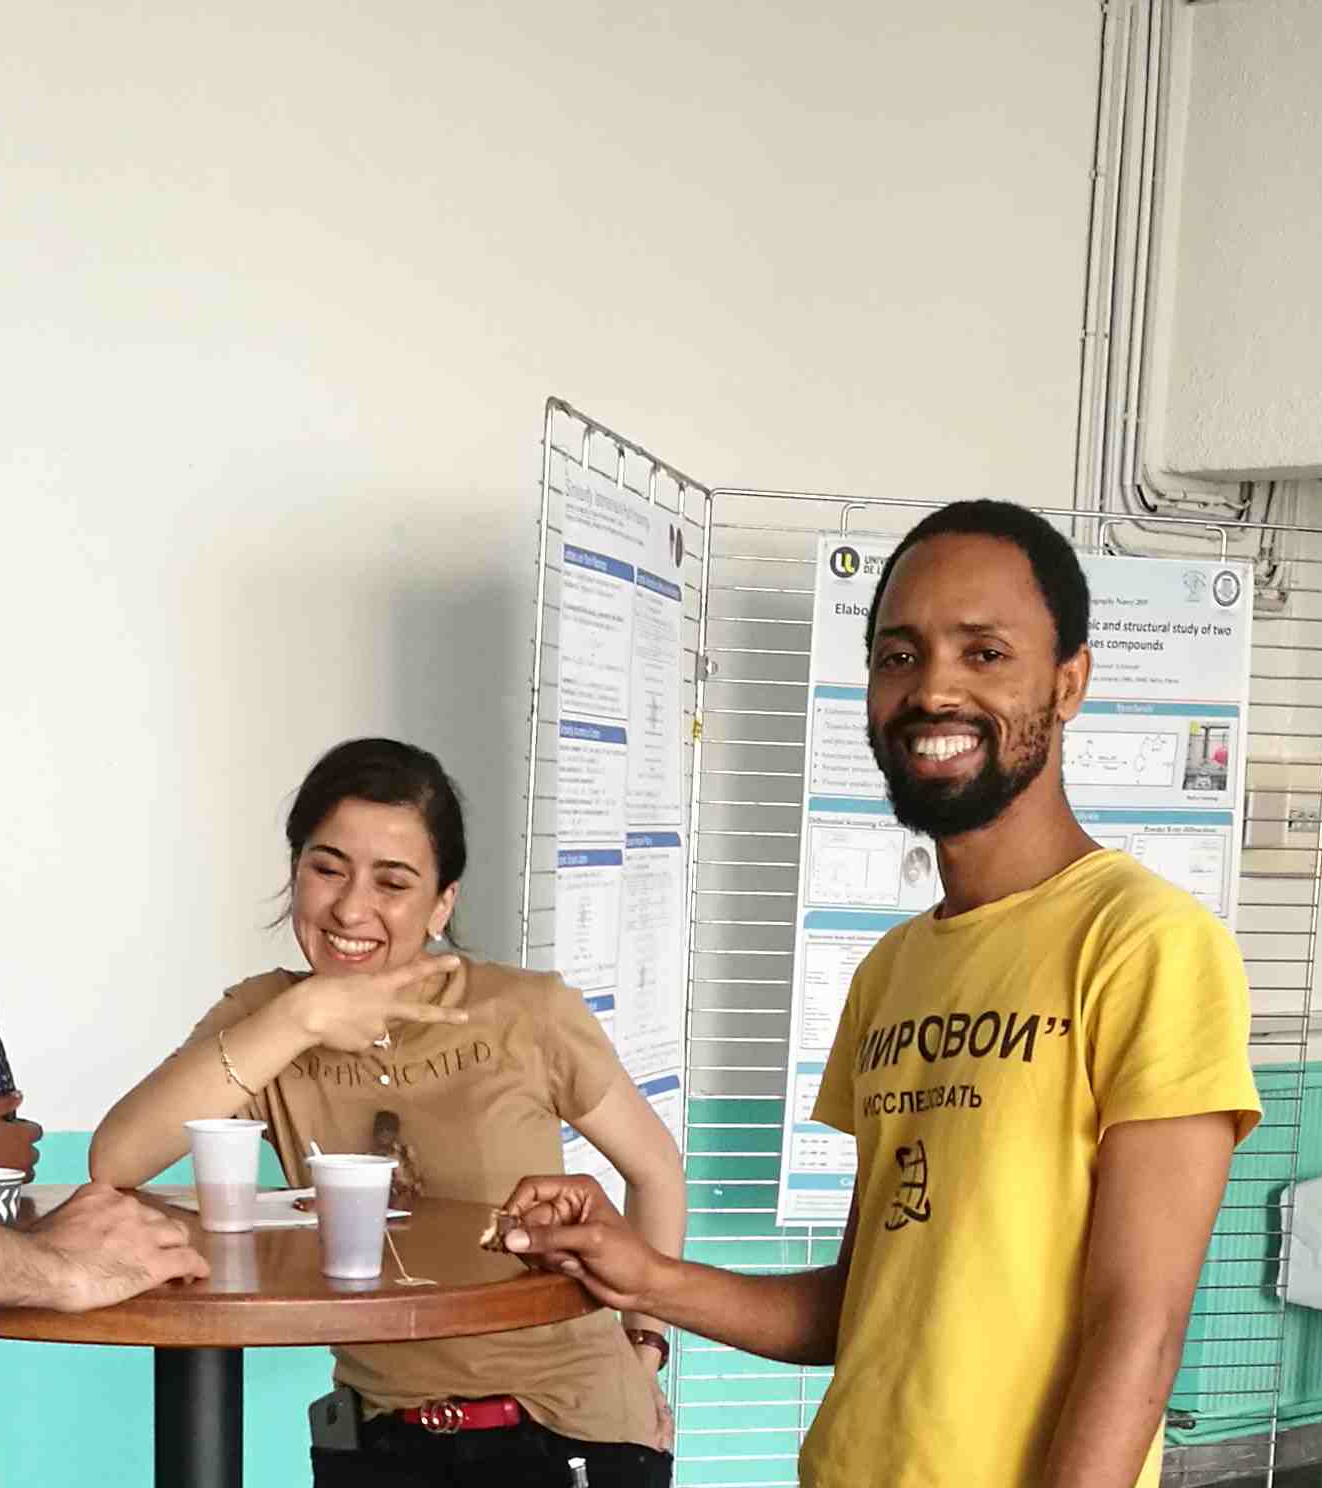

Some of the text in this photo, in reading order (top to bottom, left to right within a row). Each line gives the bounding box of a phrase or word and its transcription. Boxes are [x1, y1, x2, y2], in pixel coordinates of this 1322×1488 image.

[1102, 620, 1120, 632] and
[1123, 620, 1171, 634] structural
[1172, 623, 1199, 637] study
[1201, 623, 1212, 635] of
[1213, 626, 1232, 637] two
[1107, 639, 1164, 653] compounds
